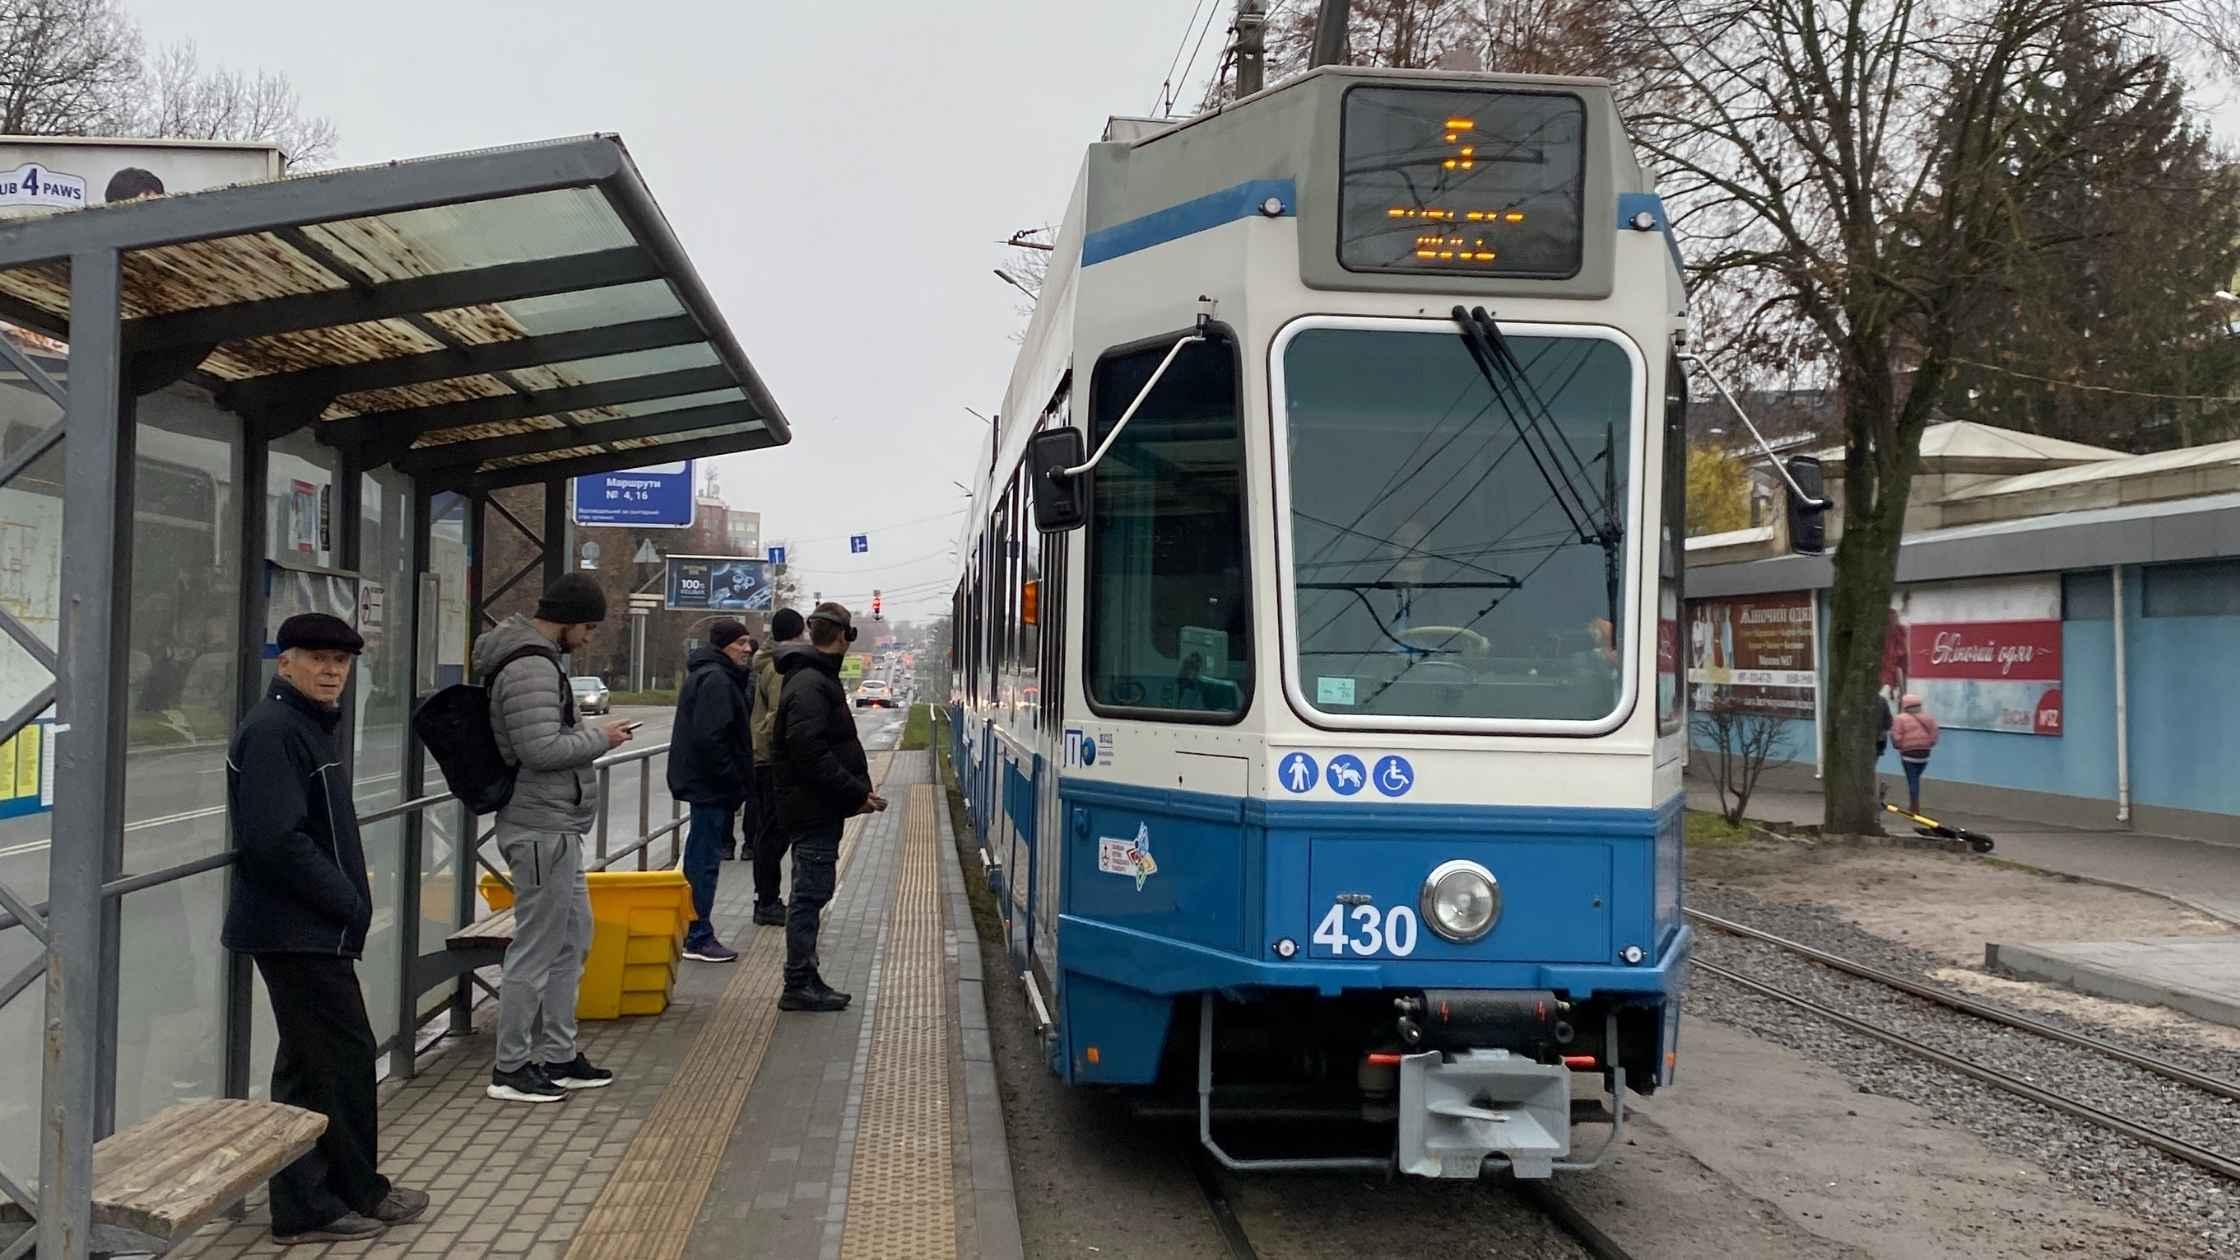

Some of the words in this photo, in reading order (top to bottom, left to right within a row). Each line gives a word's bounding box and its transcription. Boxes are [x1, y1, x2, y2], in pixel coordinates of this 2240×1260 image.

[21, 168, 39, 196] 4
[43, 182, 81, 200] PAWS
[606, 478, 661, 490] Маршрути
[1313, 904, 1418, 957] 430
